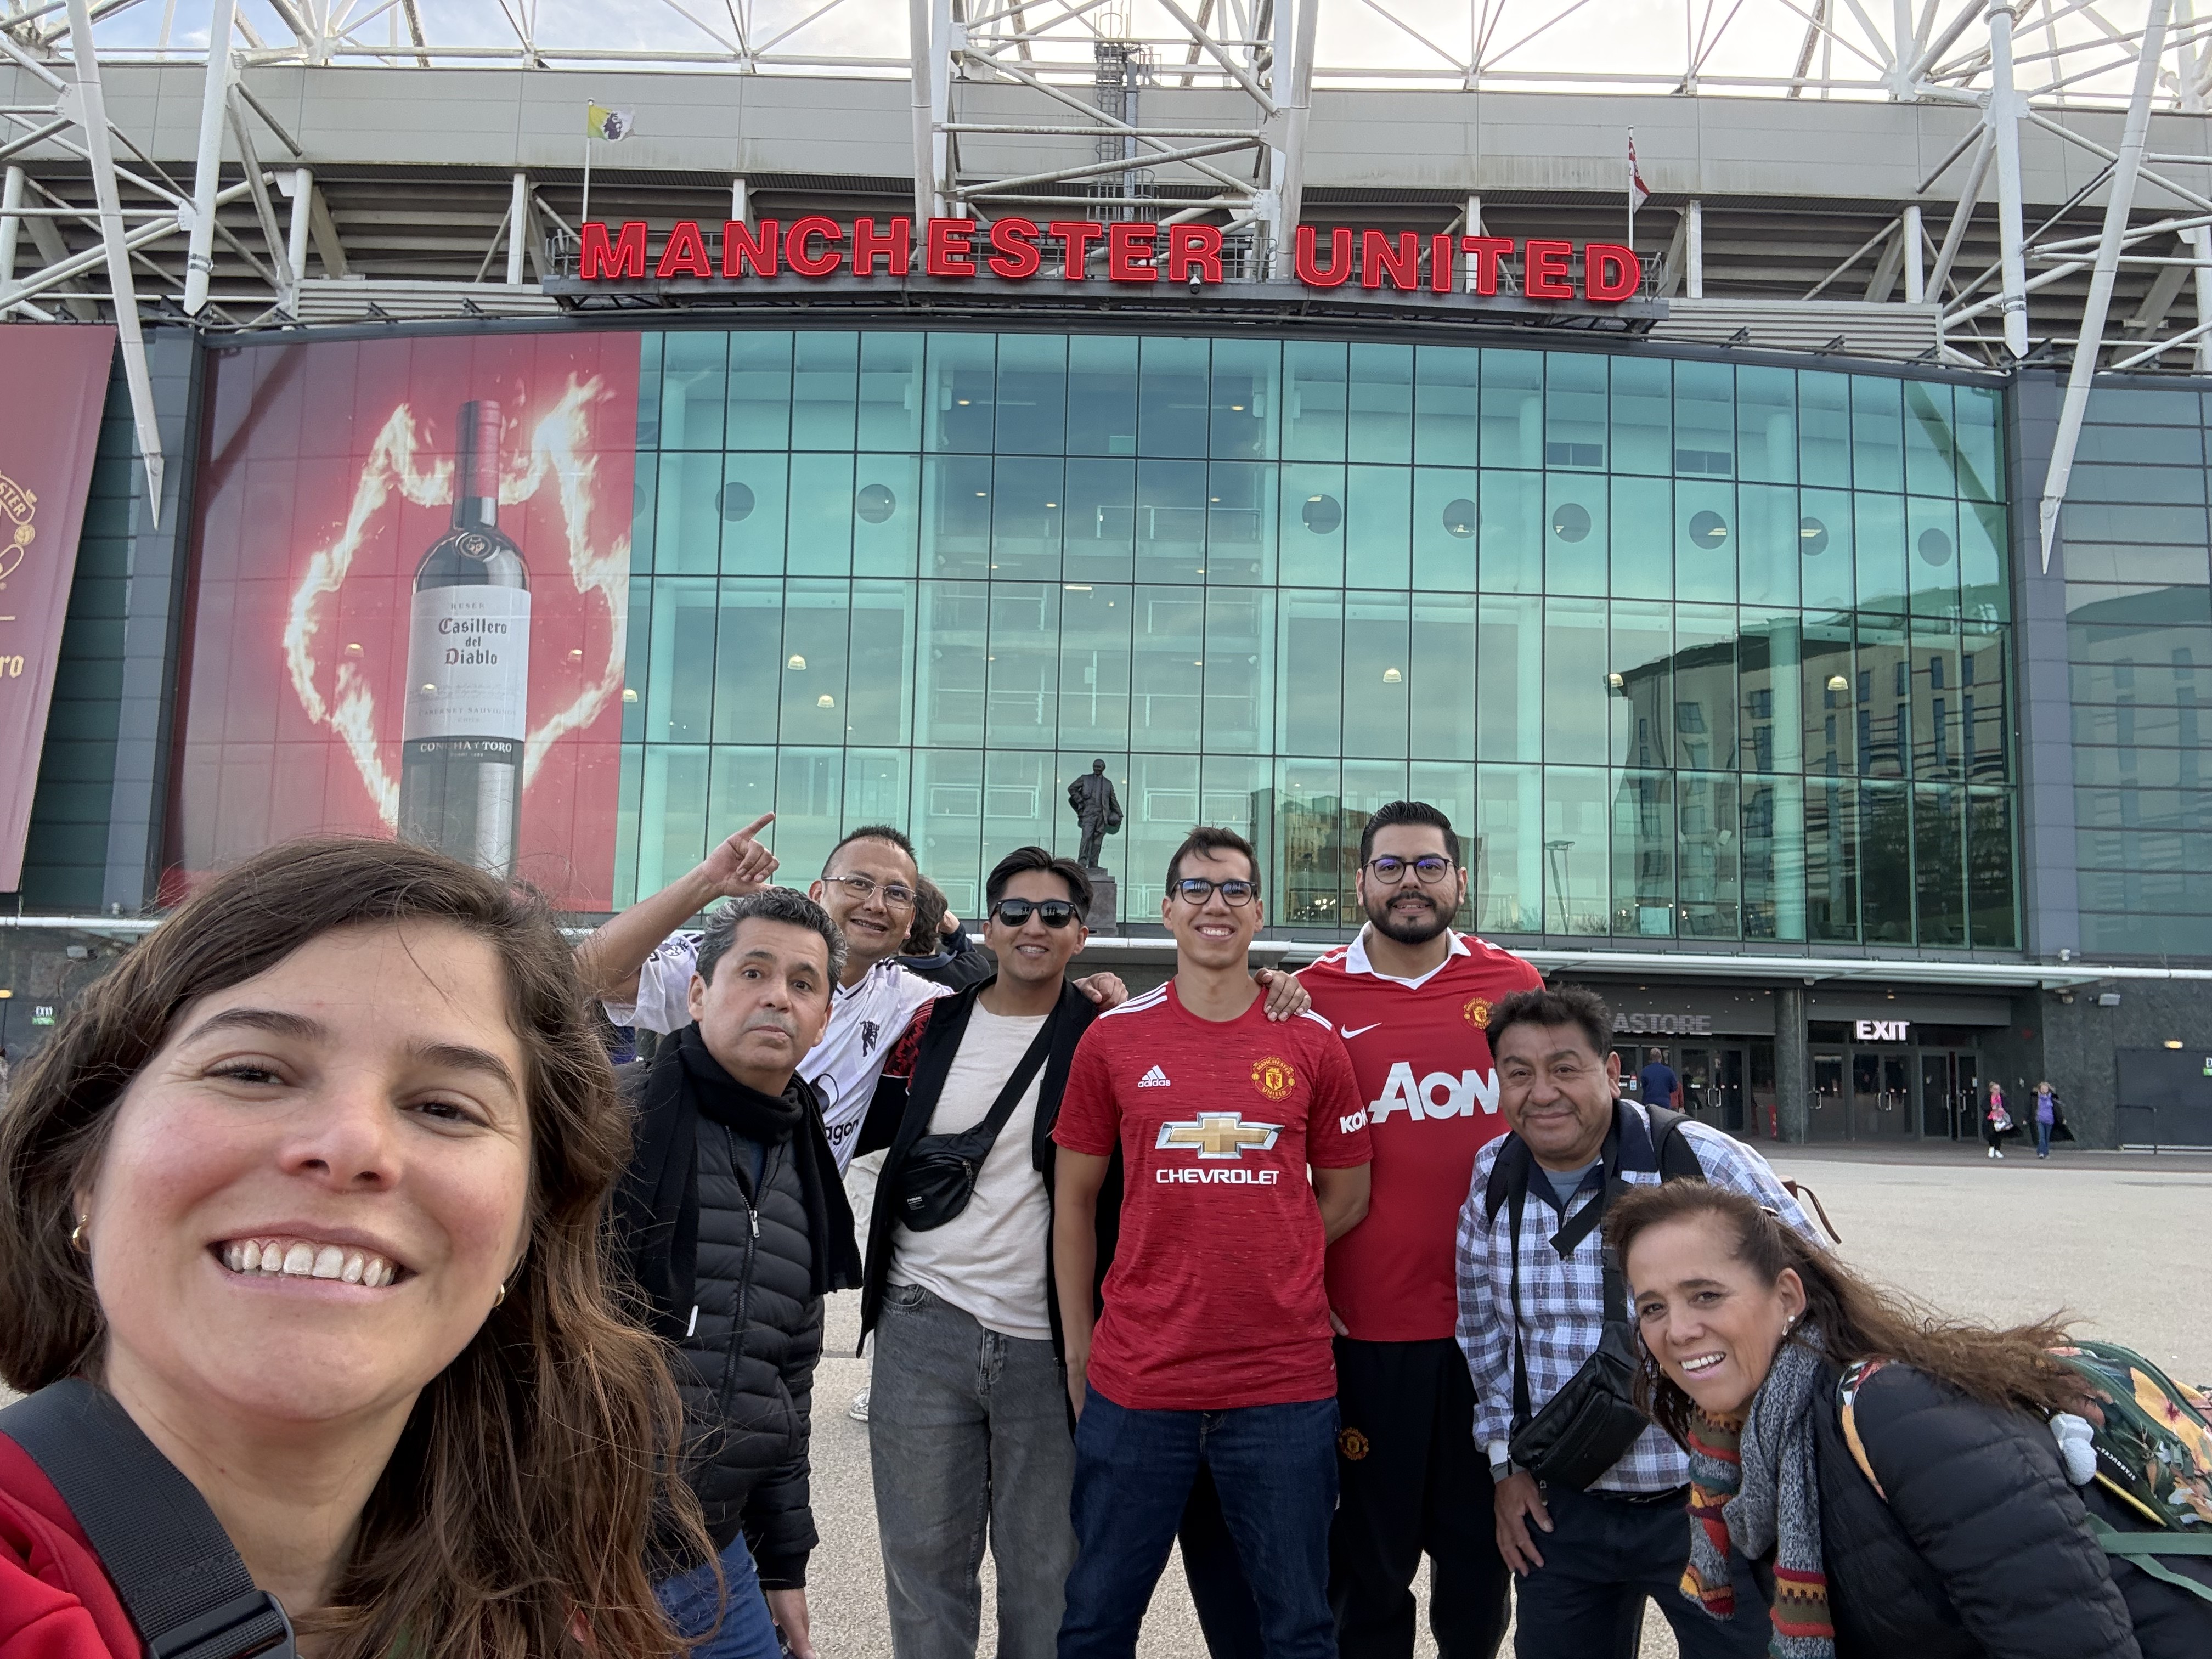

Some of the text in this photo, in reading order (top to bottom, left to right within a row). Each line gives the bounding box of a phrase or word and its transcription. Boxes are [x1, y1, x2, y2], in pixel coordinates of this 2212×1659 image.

[580, 216, 1641, 302] MANCHESTER UNITED
[439, 618, 507, 634] Casillero
[465, 636, 481, 647] del
[445, 648, 498, 665] Diablo
[420, 741, 471, 753] CONHA
[482, 741, 512, 753] TORO
[1612, 1013, 1712, 1033] ASTORE
[1857, 1020, 1910, 1041] EXIT
[1137, 1079, 1171, 1088] adidas
[1262, 1086, 1286, 1097] UNITED
[1367, 1061, 1500, 1124] AON
[1156, 1169, 1279, 1185] CHEVROLET
